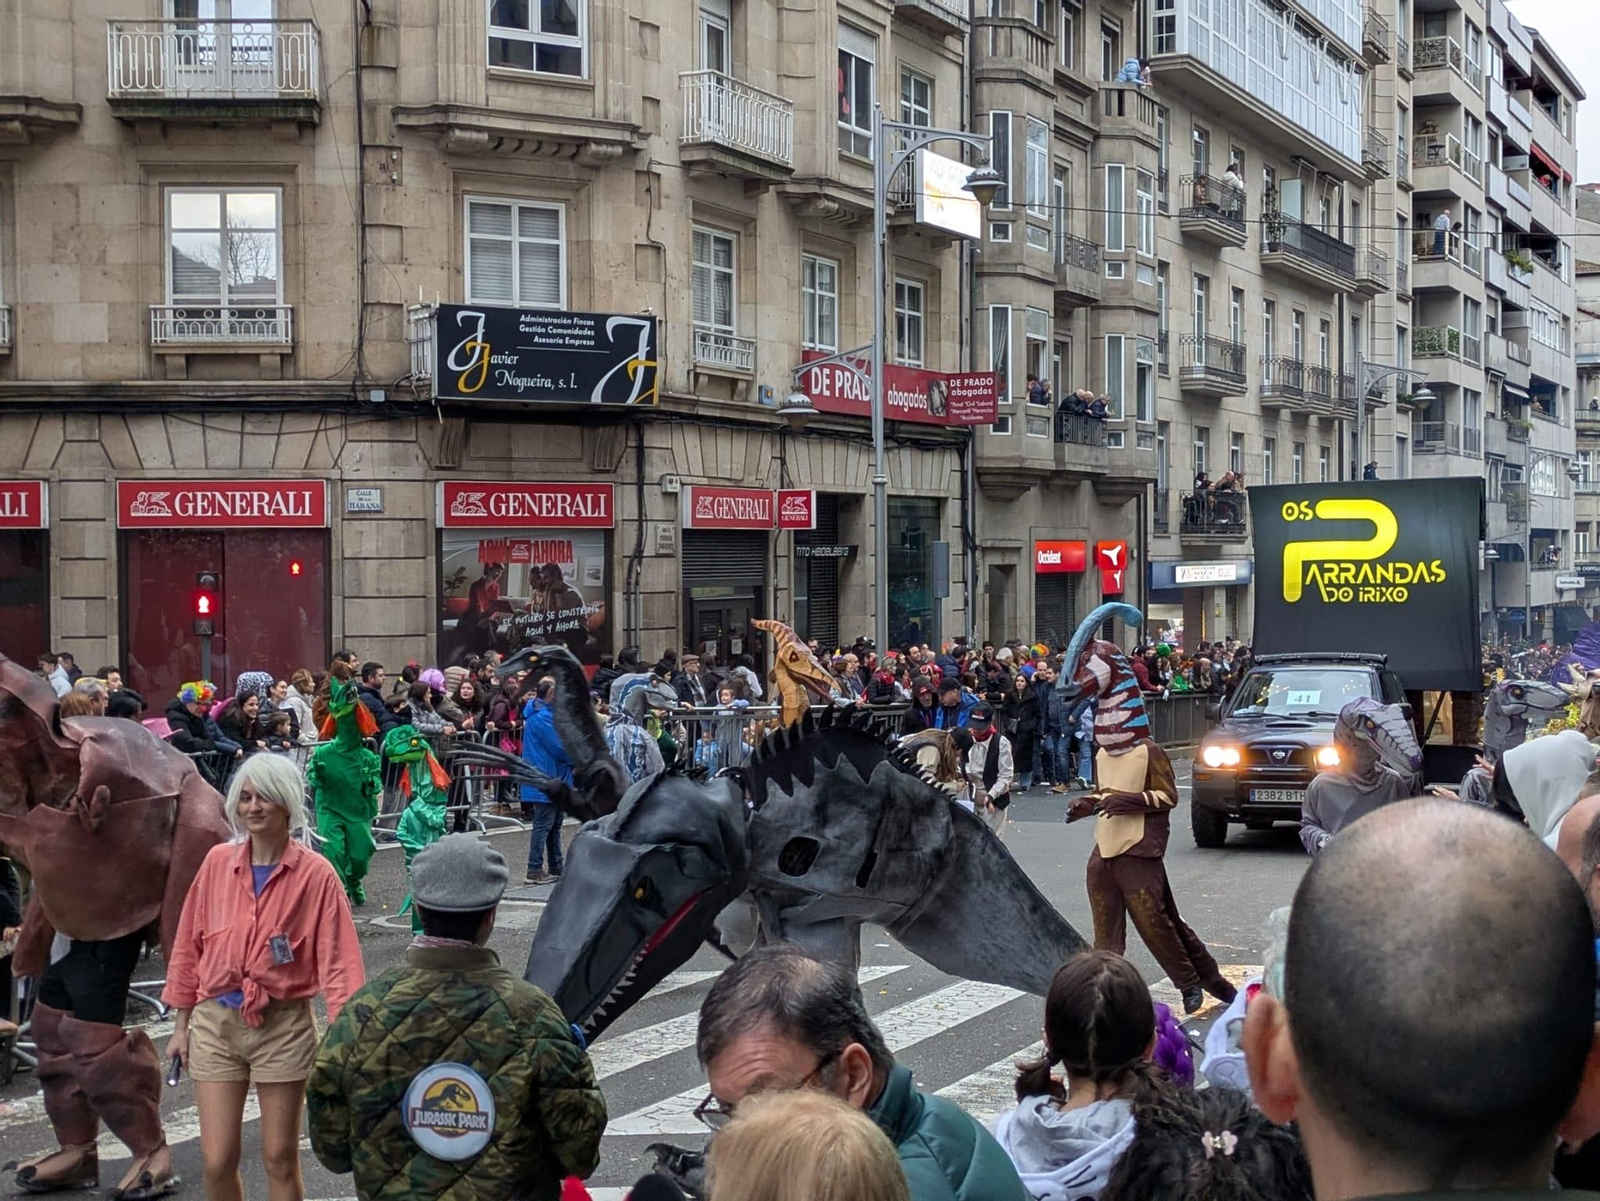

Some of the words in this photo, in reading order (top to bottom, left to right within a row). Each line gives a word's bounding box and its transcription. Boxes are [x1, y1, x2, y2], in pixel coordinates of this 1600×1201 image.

[519, 314, 572, 325] Administración
[573, 317, 595, 326] Fincas
[519, 324, 546, 334] Gestión
[547, 327, 595, 336] Comunidades
[533, 335, 563, 345] Asesoría
[564, 337, 595, 346] Empresa
[495, 370, 555, 393] Nogueira,
[558, 378, 567, 389] s.
[811, 366, 830, 397] DE
[950, 379, 961, 387] DE
[964, 377, 994, 387] PRADO
[887, 383, 927, 413] abogados
[951, 386, 992, 397] abogados
[174, 490, 313, 517] GENERALI
[489, 492, 607, 517] GENERALI
[714, 496, 770, 521] GENERALI
[1282, 500, 1313, 521] OS
[781, 514, 809, 522] GENERALI
[533, 540, 574, 563] AHORA
[796, 546, 810, 557] TITO
[1326, 587, 1354, 602] DO
[546, 610, 556, 622] SE
[1257, 790, 1283, 800] 2382
[413, 1109, 457, 1127] JURASSIC
[458, 1112, 487, 1129] PARK
